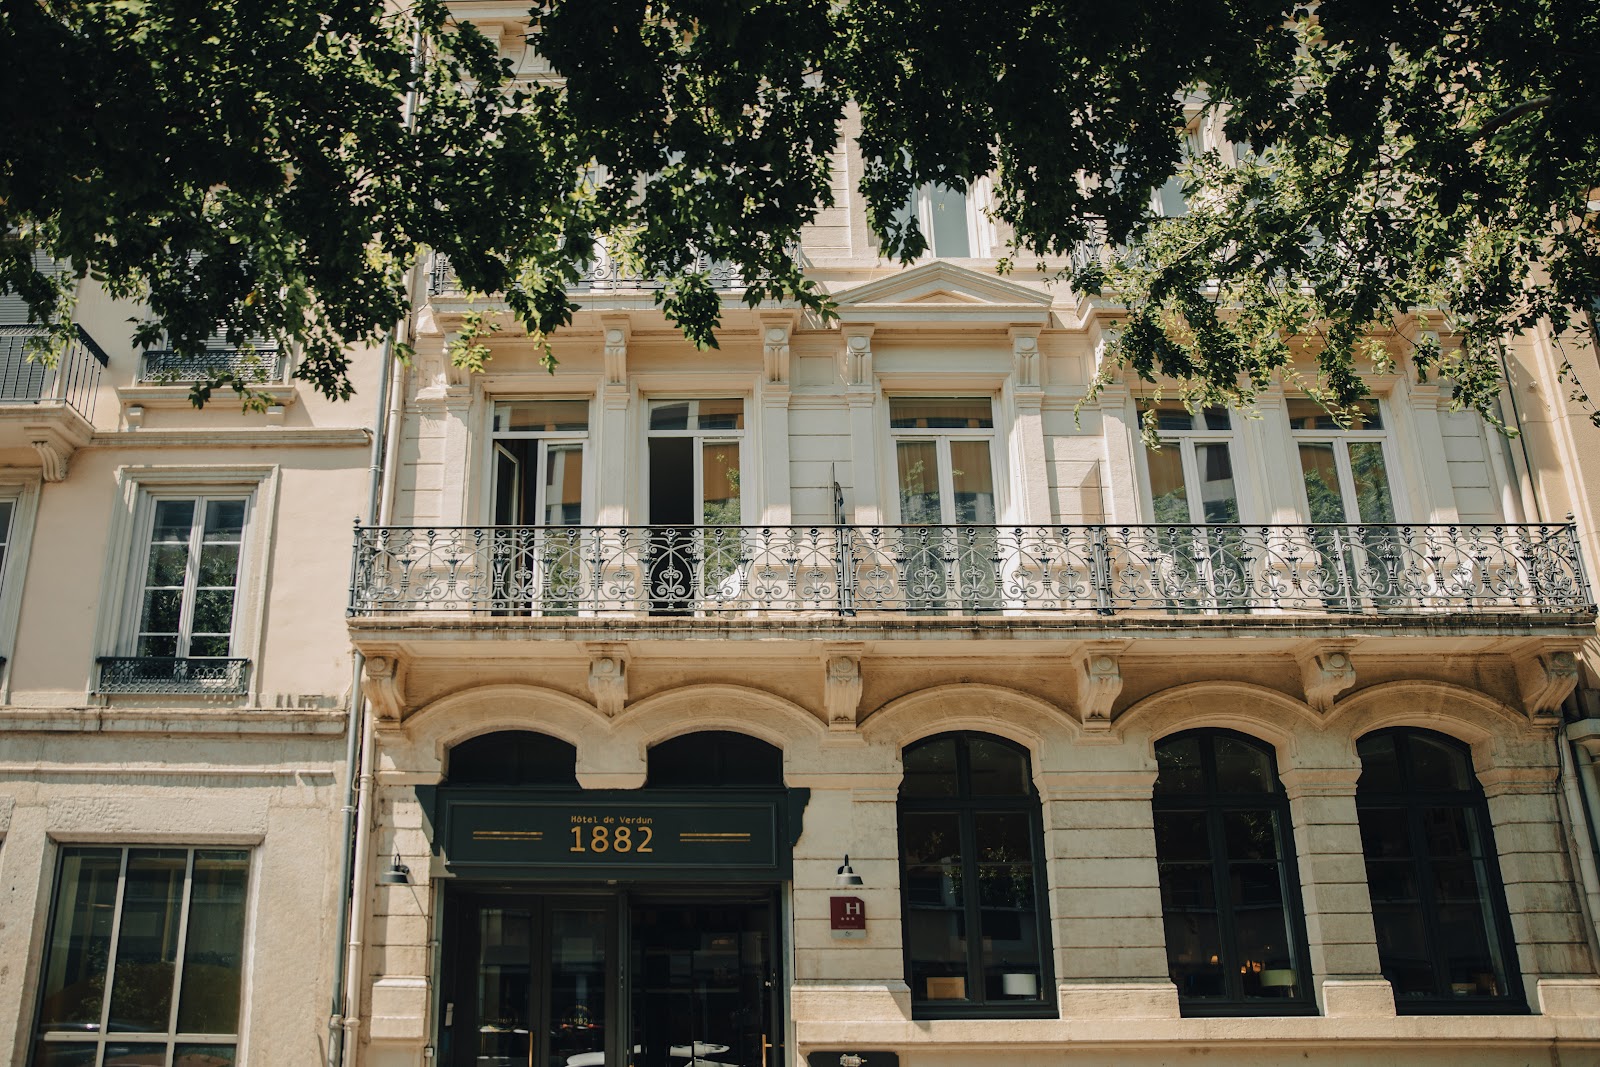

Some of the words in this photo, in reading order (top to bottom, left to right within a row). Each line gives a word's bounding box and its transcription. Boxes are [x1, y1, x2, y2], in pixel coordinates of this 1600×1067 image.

[603, 816, 615, 824] de
[619, 816, 653, 824] Verdun
[570, 826, 653, 852] 1882
[846, 903, 860, 914] H
